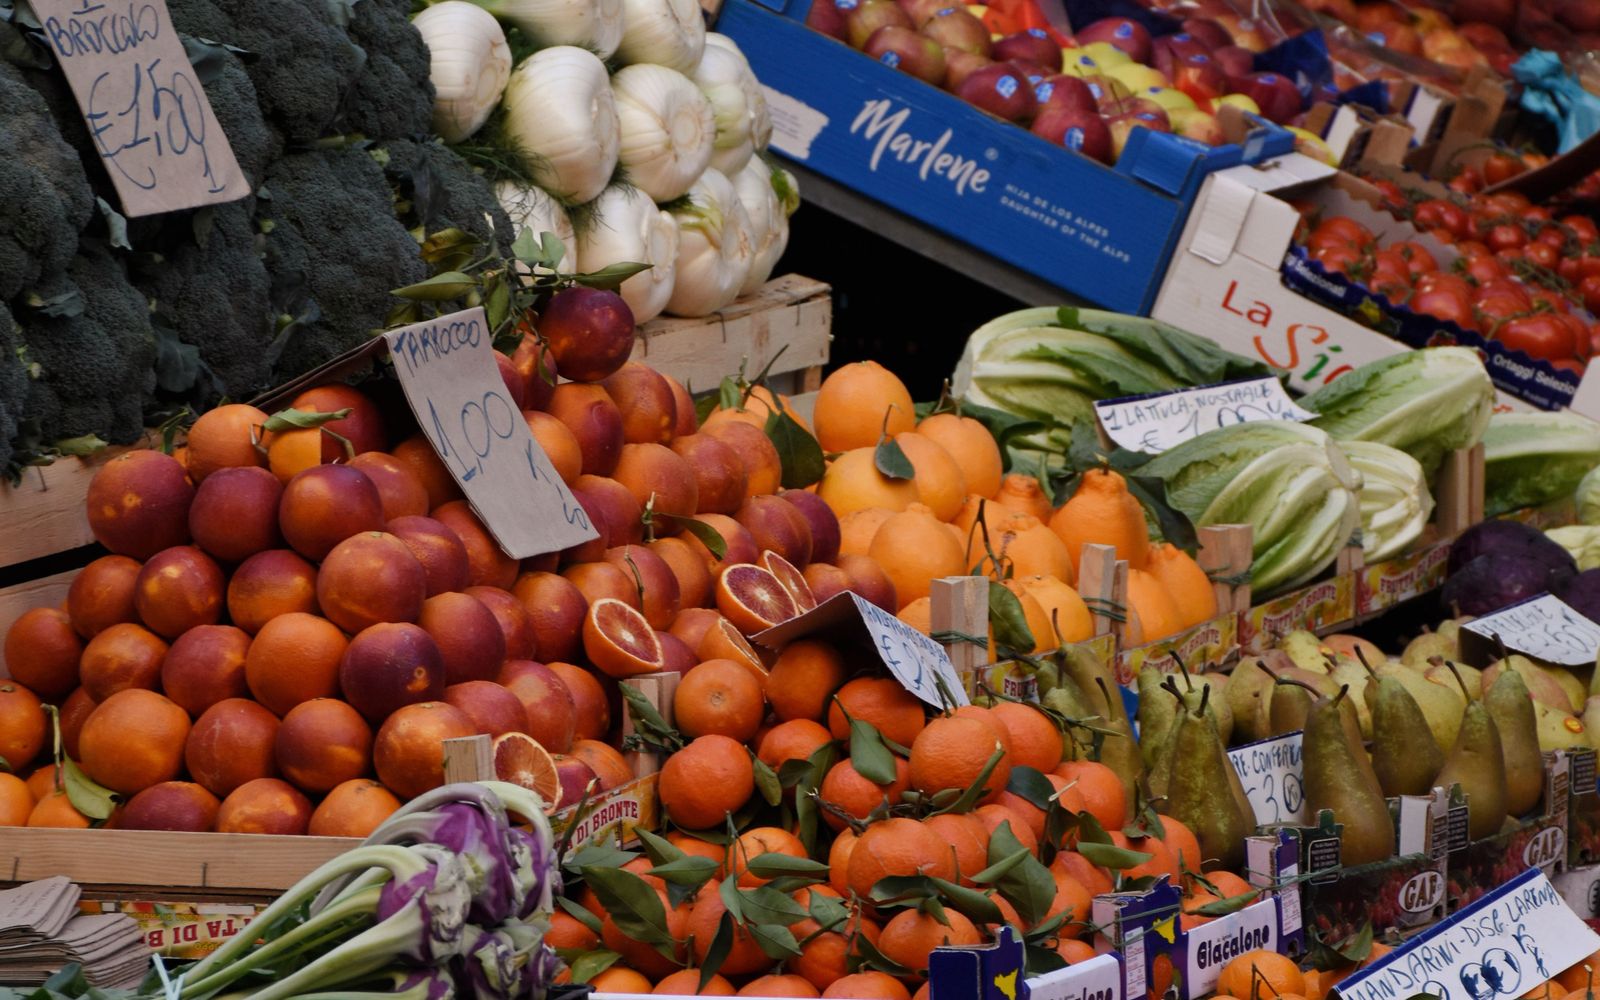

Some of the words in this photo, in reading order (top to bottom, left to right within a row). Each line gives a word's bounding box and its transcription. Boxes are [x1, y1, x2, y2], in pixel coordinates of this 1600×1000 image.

[850, 98, 991, 196] Marlene
[1000, 195, 1058, 228] DAUGHTER
[1061, 224, 1076, 236] OF
[1080, 232, 1100, 248] THE
[1102, 245, 1130, 263] ALPS
[1075, 216, 1109, 238] ALPES
[1221, 279, 1273, 329] La
[1535, 370, 1575, 395] Selezio
[576, 821, 589, 845] DI
[592, 800, 638, 833] BRONTE
[173, 923, 198, 945] DI
